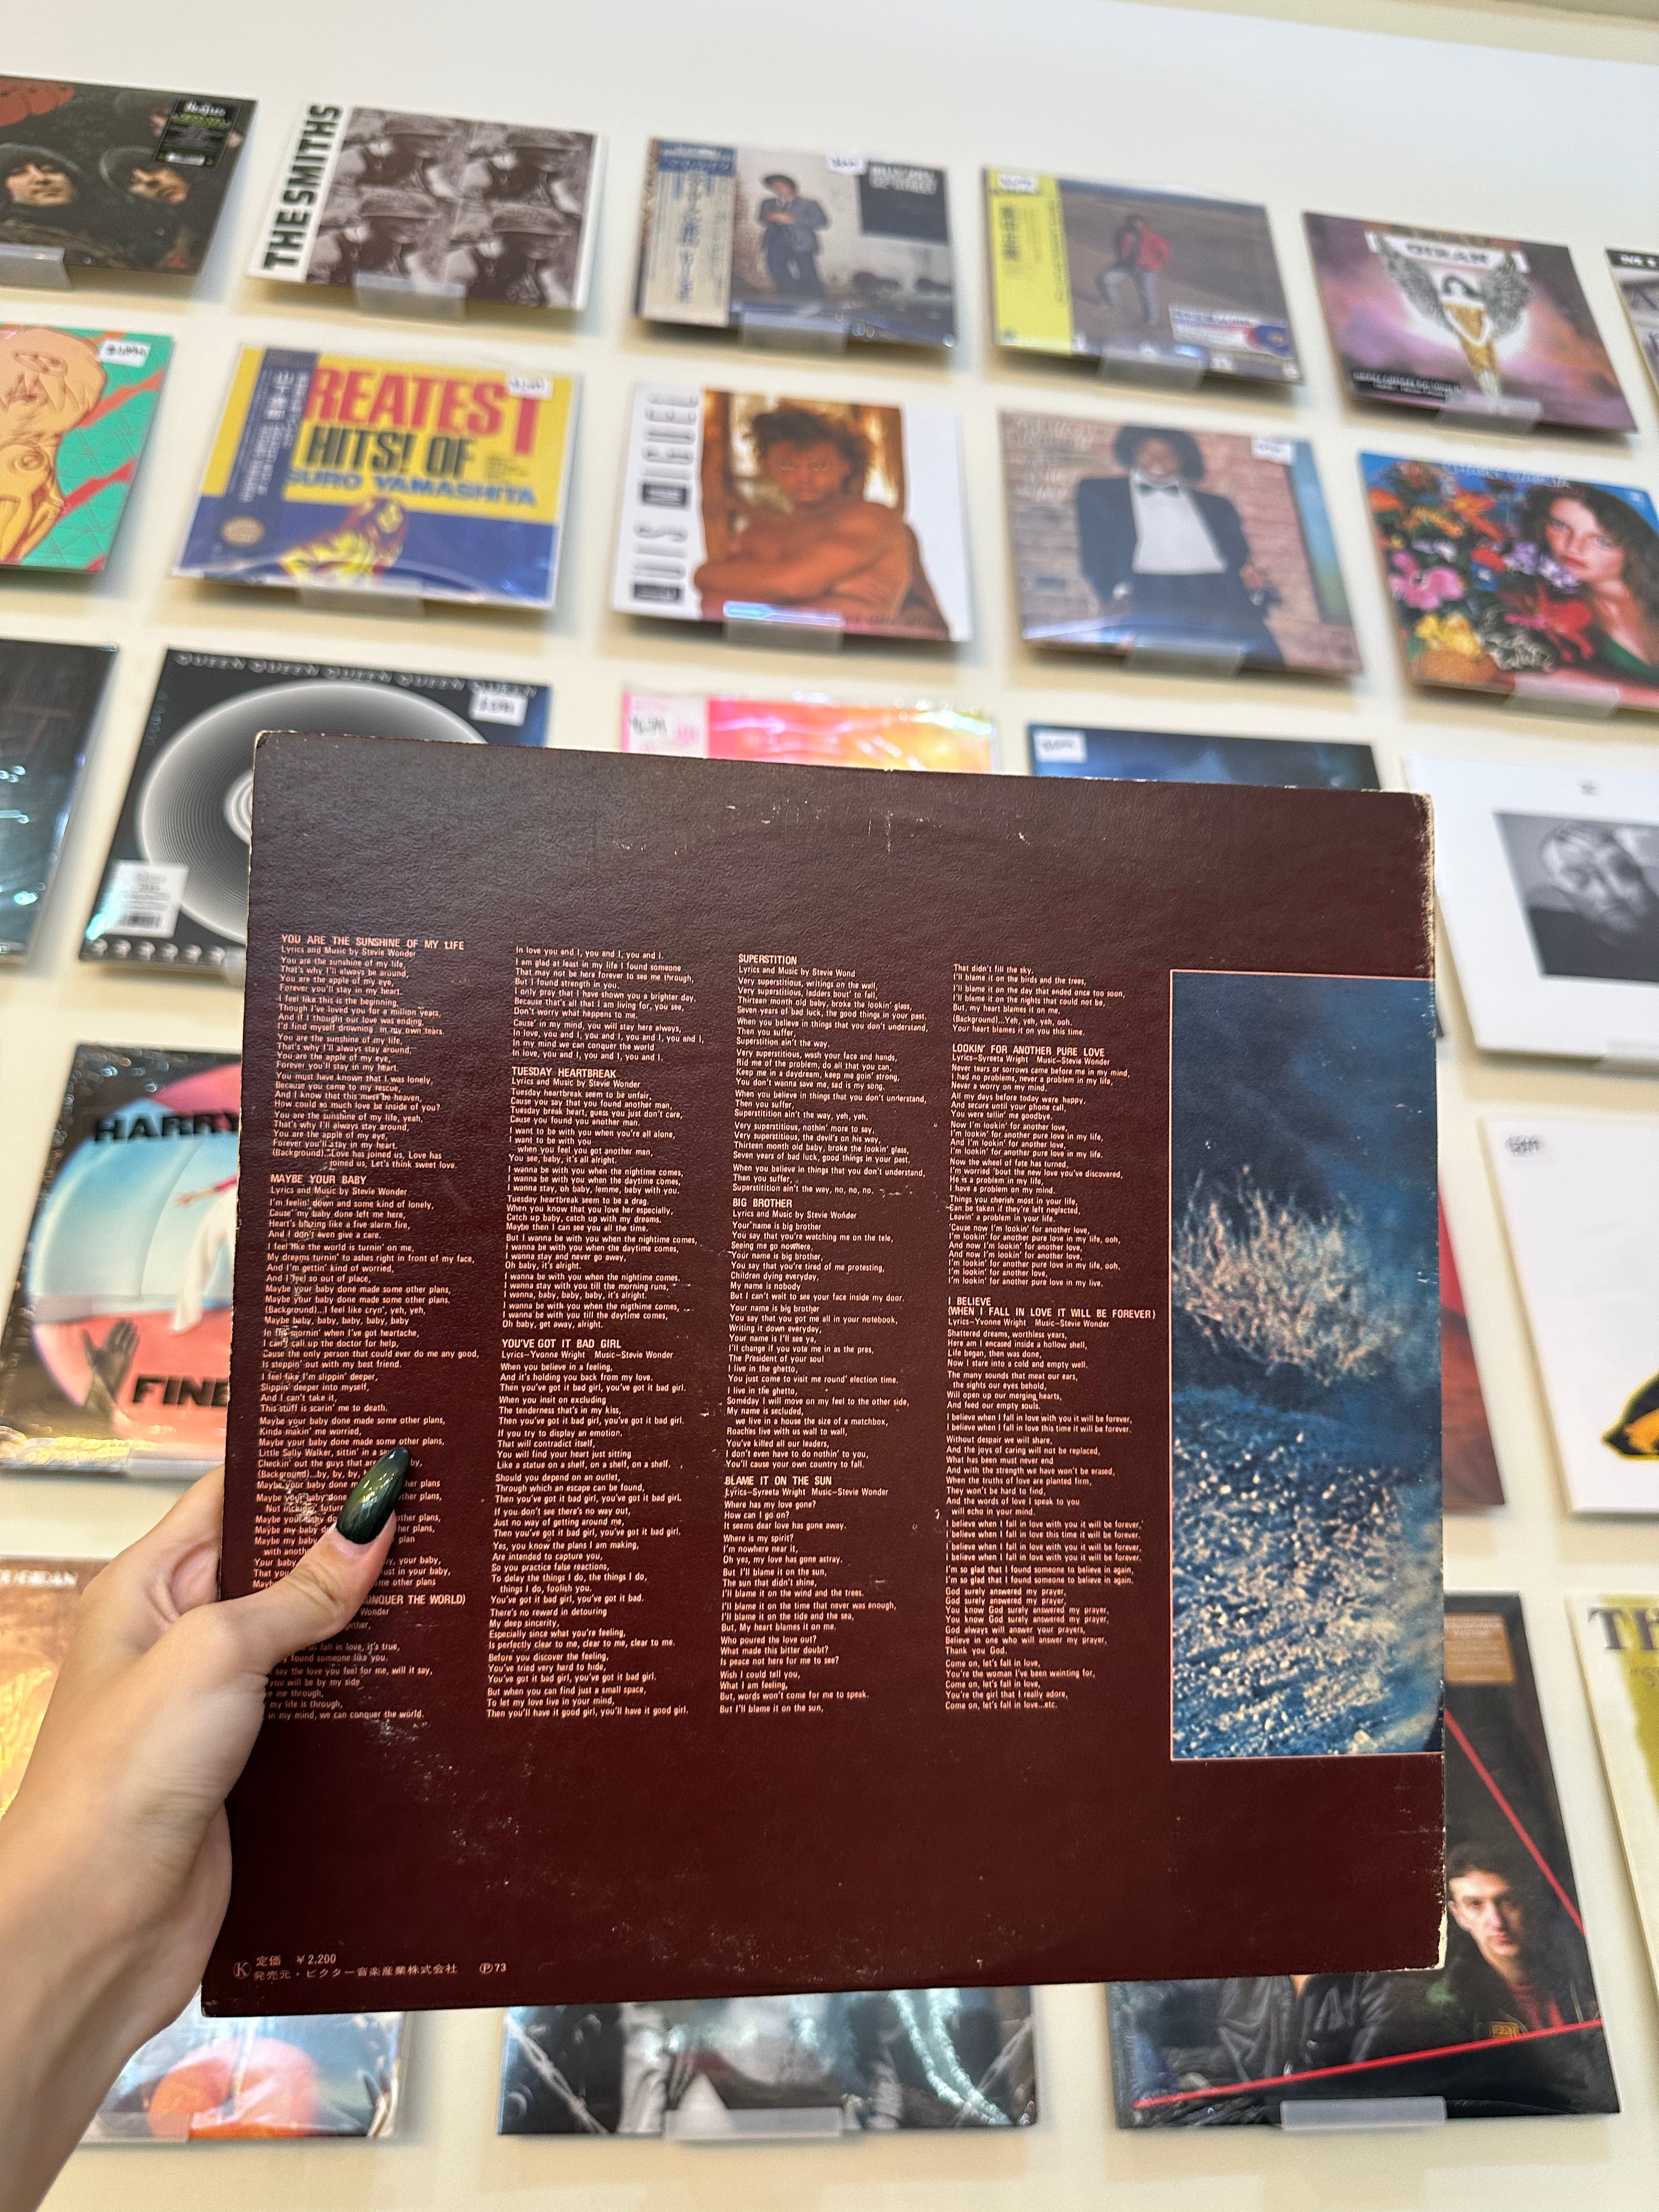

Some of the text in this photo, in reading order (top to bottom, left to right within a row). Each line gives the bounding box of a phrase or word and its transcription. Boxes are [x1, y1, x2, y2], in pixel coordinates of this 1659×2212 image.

[264, 104, 342, 269] THE SMITHS
[306, 426, 417, 473] HITS!
[426, 436, 476, 478] OF
[374, 476, 537, 505] YAMASHITA
[281, 934, 464, 951] YOU ARE THE SUNSHINE OF MY LIFE
[738, 953, 797, 966] SUPERSTITION
[738, 964, 855, 978] Lyrics and Music by Stevie Wond
[514, 1007, 534, 1015] Don't
[537, 1009, 559, 1018] worry
[562, 1008, 580, 1018] what
[582, 1009, 612, 1019] happens
[952, 1043, 1105, 1057] LOOKIN' FOR ANOTHER PURE LOVE
[511, 1066, 617, 1079] TUESDAY HEARTBREAK
[511, 1076, 641, 1089] Lyrics and Music by Stevie Wonder
[736, 1077, 750, 1086] You
[753, 1077, 771, 1087] don't
[831, 1080, 843, 1089] sad
[845, 1080, 851, 1089] is
[852, 1081, 865, 1091] my
[270, 1173, 367, 1185] MAYBE YOUR BABY
[732, 1198, 792, 1209] BIG BROTHER
[948, 1296, 991, 1306] I BELIEVE
[947, 1305, 1156, 1319] (WHEN I FALL IN LOVE IT WILL BE FOREVER)
[729, 1323, 755, 1334] Writing
[757, 1323, 763, 1332] it
[765, 1324, 785, 1333] down
[947, 1328, 980, 1338] Shattered
[1012, 1330, 1045, 1339] worthless
[501, 1338, 622, 1348] YOU'VE GOT IT BAD GIRL
[259, 1415, 285, 1426] Maybe
[288, 1418, 306, 1426] your
[309, 1417, 329, 1426] baby
[331, 1416, 351, 1425] done
[353, 1416, 374, 1425] made
[399, 1415, 421, 1424] other
[724, 1474, 832, 1486] BLAME IT ON THE SUN
[724, 1499, 816, 1510] Where has my love gone?
[945, 1586, 960, 1596] God
[964, 1587, 985, 1597] surely
[990, 1587, 1022, 1596] answered
[1026, 1588, 1037, 1596] my
[362, 1593, 466, 1605] ONQUER THE WORLD)
[489, 1629, 527, 1640] Especially
[529, 1629, 548, 1638] since
[550, 1629, 569, 1638] what
[572, 1628, 596, 1639] you're
[720, 1645, 829, 1656] What made this bitter doubt?
[945, 1646, 967, 1655] Thank
[972, 1647, 985, 1656] you
[945, 1701, 966, 1710] Come
[983, 1700, 997, 1710] let's
[1000, 1700, 1012, 1709] fall
[1014, 1700, 1021, 1709] in
[256, 1955, 281, 1967] 定価
